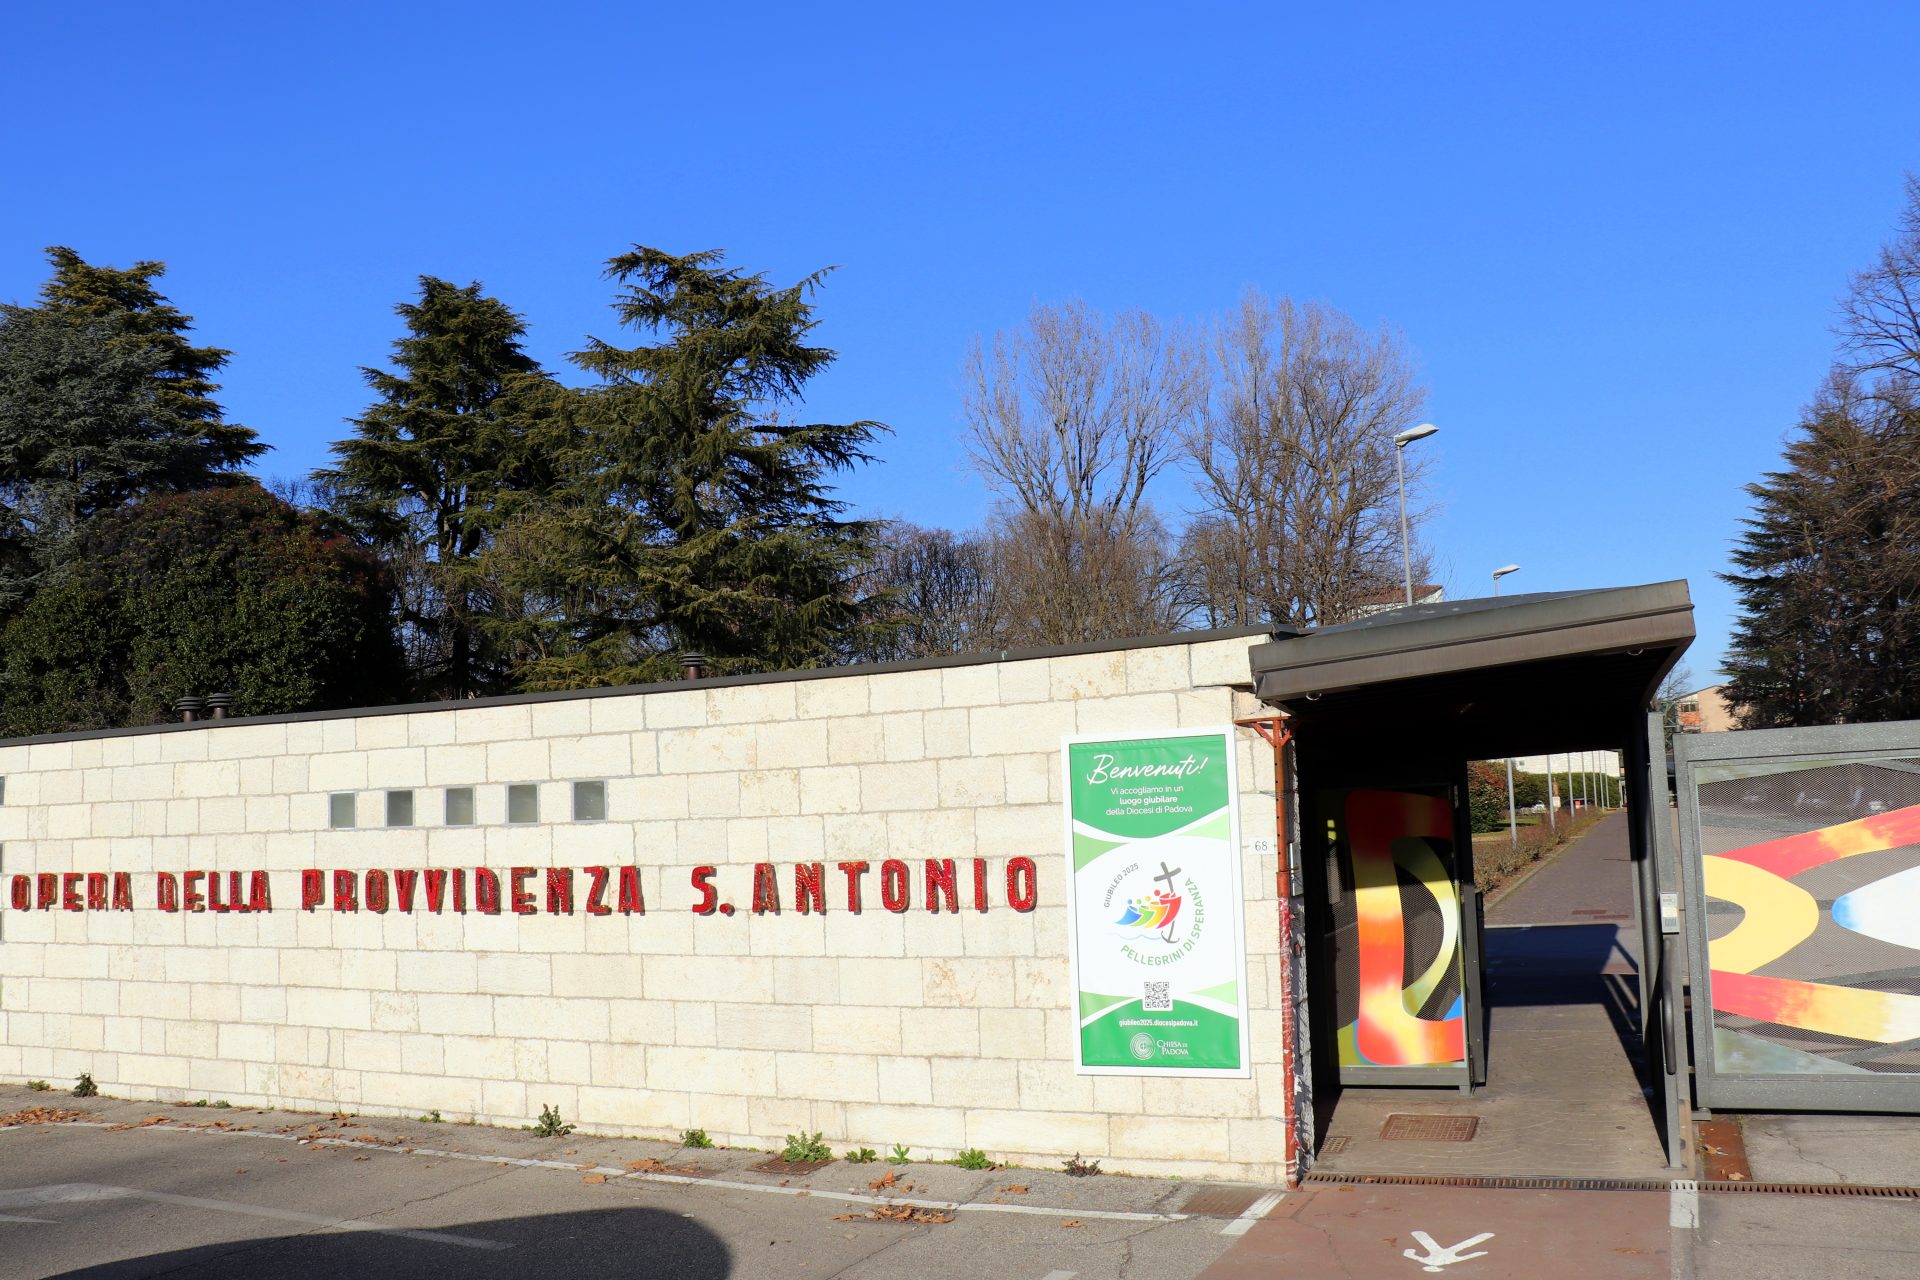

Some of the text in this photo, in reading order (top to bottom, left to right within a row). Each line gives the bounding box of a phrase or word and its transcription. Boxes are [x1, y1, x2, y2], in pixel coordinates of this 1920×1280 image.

[1086, 754, 1208, 784] Benvenuti!
[1110, 786, 1118, 795] Vi
[1119, 786, 1163, 796] accogliamo
[1165, 785, 1173, 793] in
[1119, 795, 1178, 806] luogo giubilare
[1106, 804, 1193, 816] della Diocesi di Padova
[1255, 841, 1268, 851] 68
[11, 871, 131, 911] OPERA
[157, 870, 271, 912] DELLA
[302, 866, 644, 915] PROVVIDENZA
[1104, 862, 1139, 908] GIUBILEO 2025
[1121, 877, 1205, 966] PELLEGRINI DI SPERANZA
